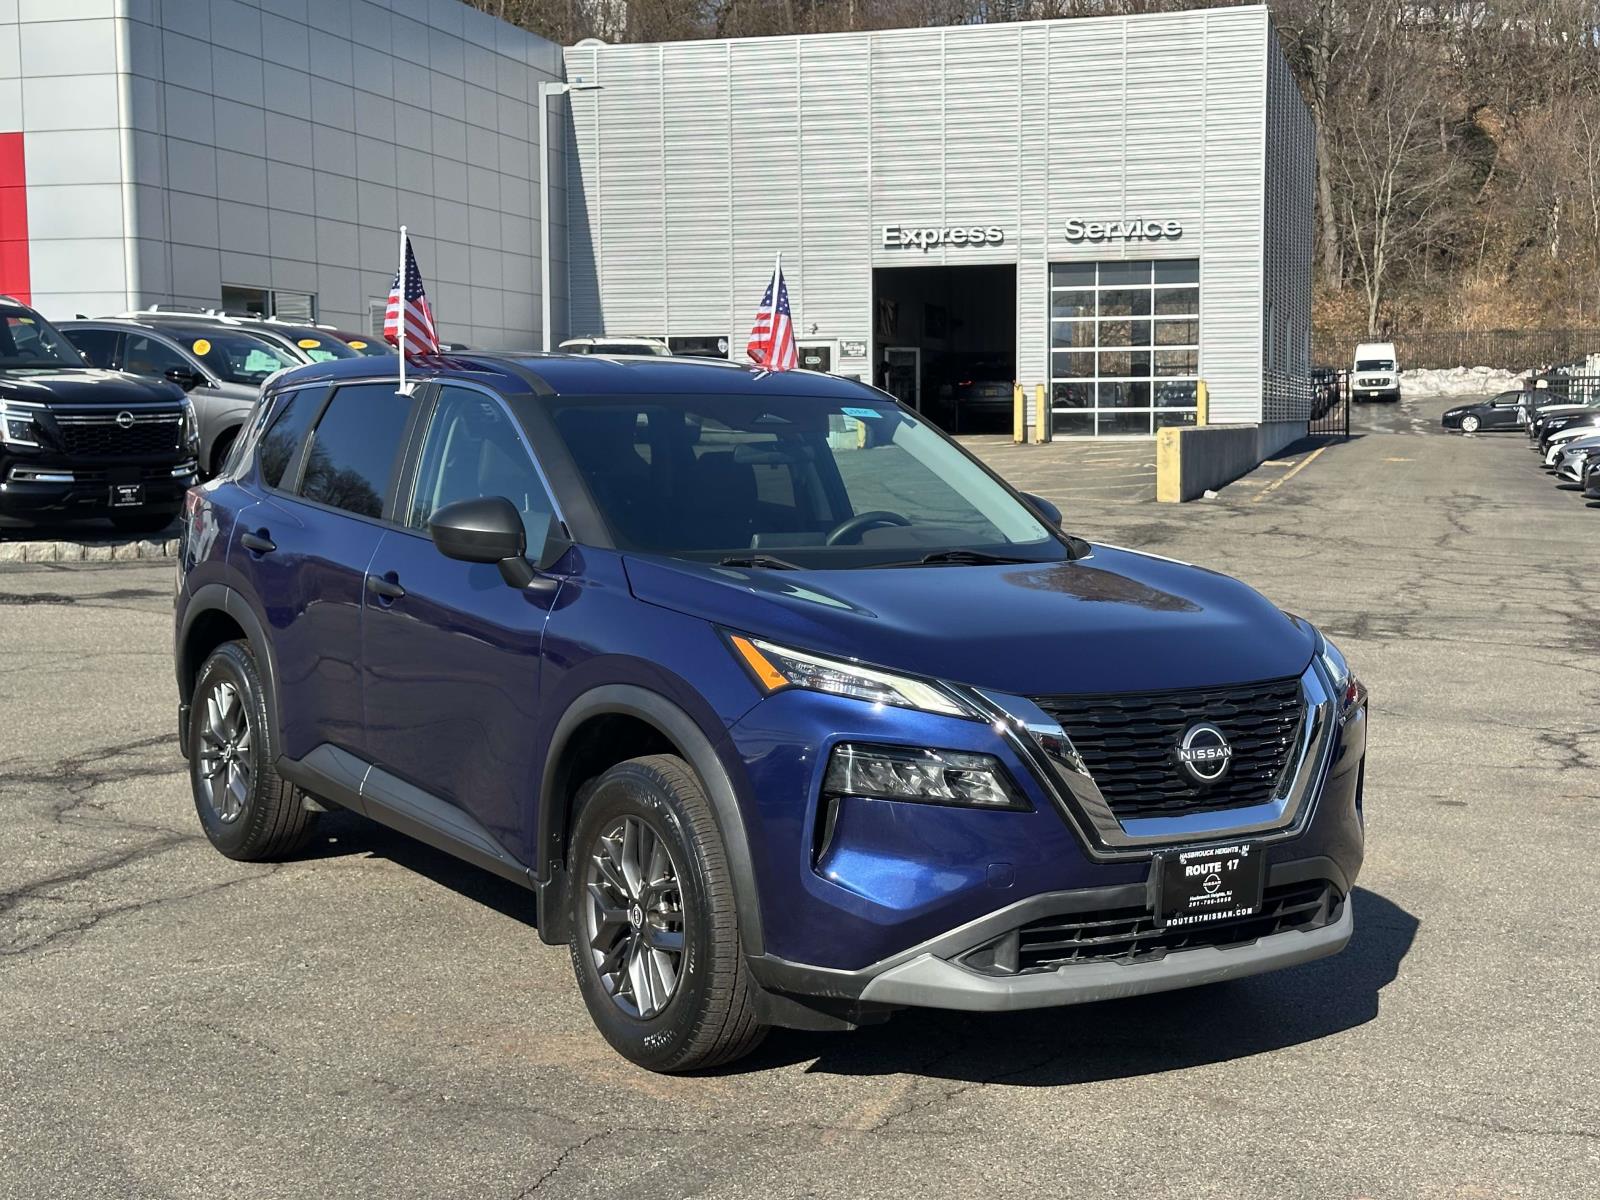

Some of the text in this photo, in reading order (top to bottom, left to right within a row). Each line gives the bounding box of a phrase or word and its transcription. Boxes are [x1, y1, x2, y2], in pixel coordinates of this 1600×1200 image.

[883, 217, 1183, 250] Express Service
[1180, 746, 1232, 760] NISSAN
[1242, 844, 1250, 852] NJ
[1185, 858, 1240, 876] ROUTE 17
[1166, 908, 1253, 927] ROUTE17NISSAN.COM
